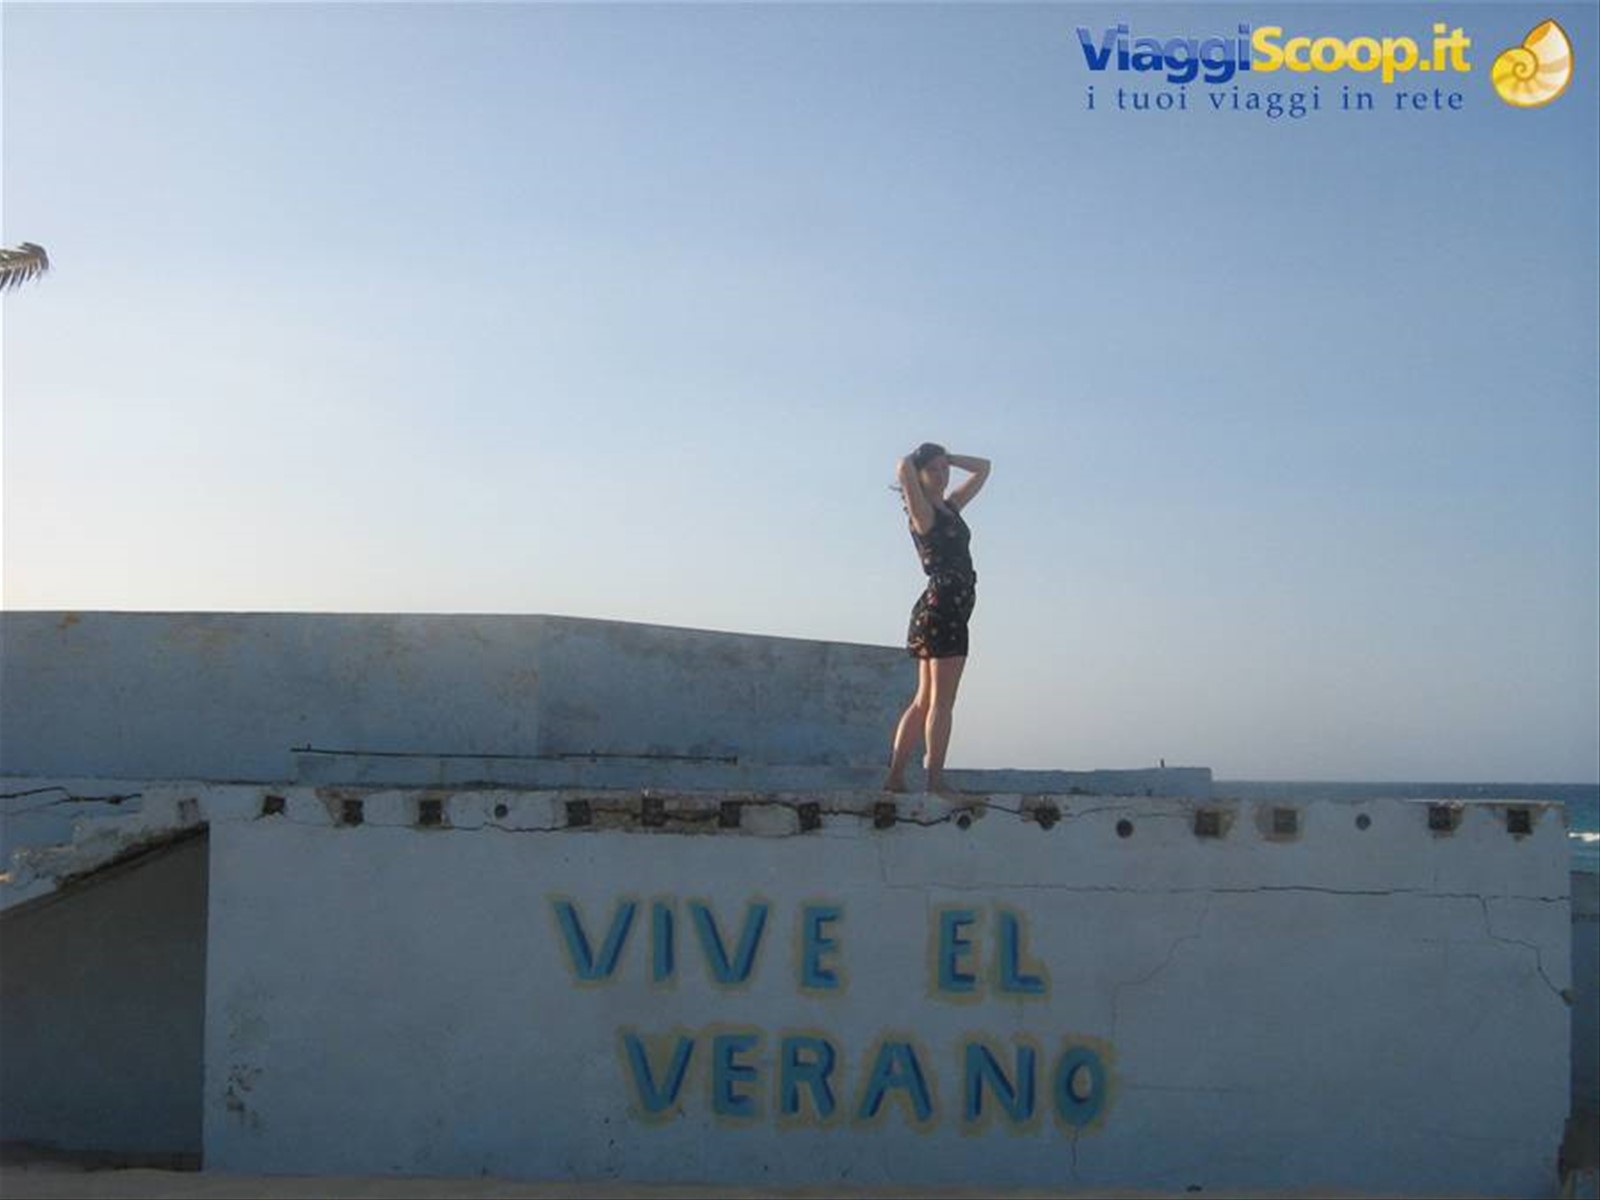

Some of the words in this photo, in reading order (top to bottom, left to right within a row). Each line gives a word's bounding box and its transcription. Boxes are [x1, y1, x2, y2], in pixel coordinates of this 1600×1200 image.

[553, 900, 843, 990] VIVE
[936, 908, 1047, 995] EL
[622, 1032, 1108, 1127] VERANO
